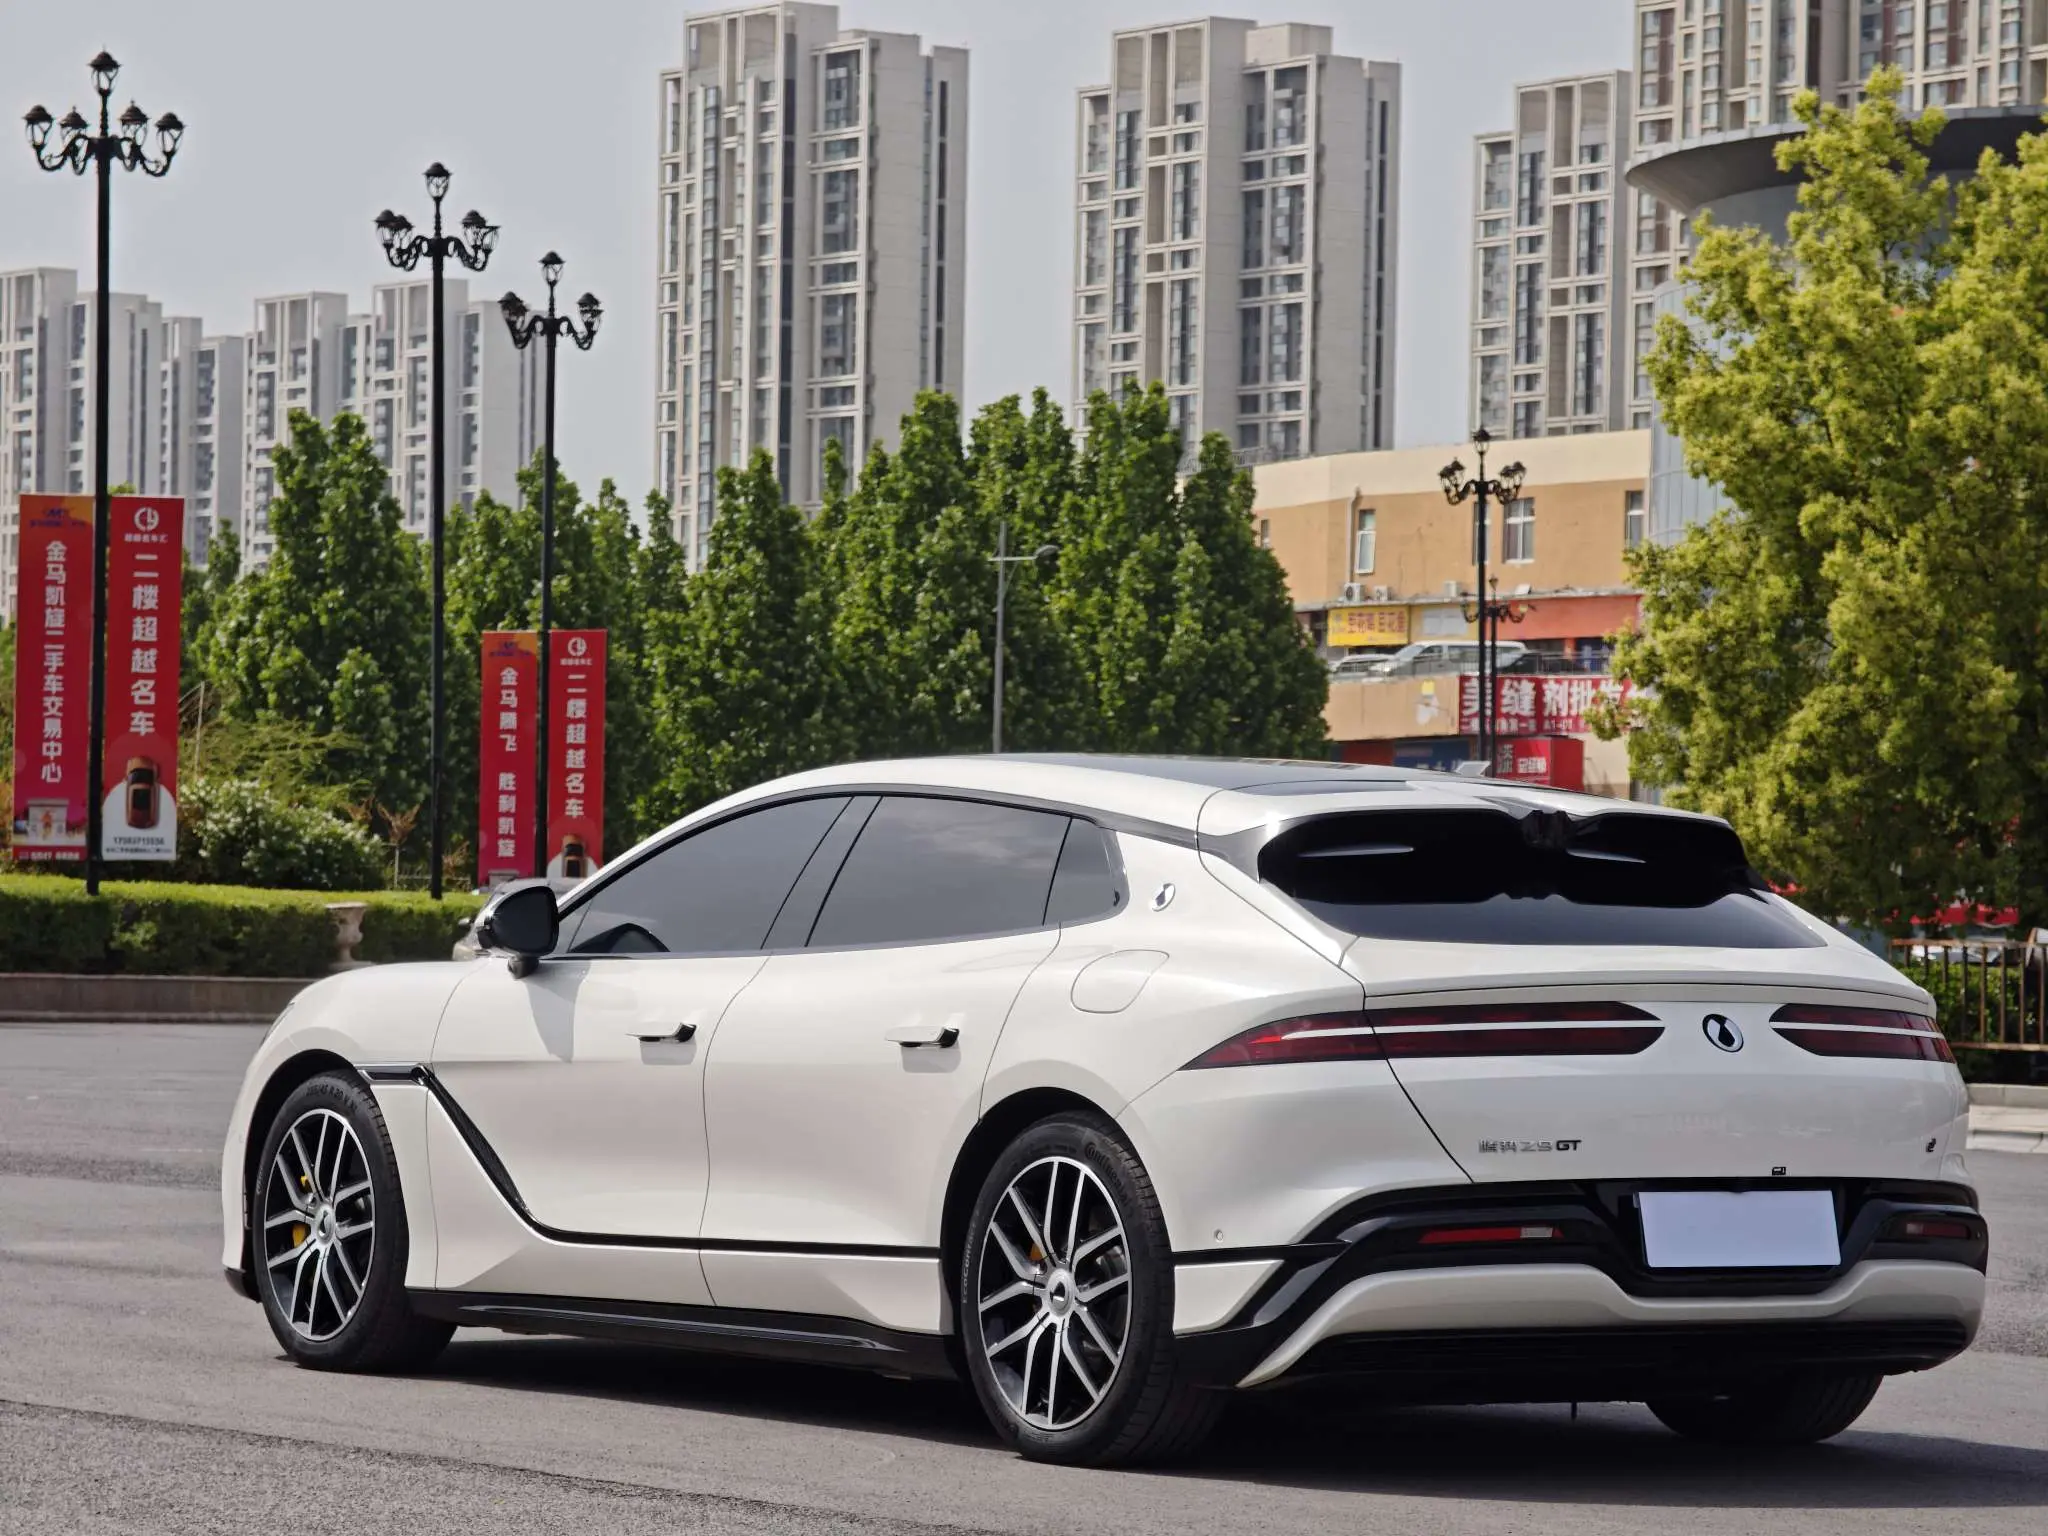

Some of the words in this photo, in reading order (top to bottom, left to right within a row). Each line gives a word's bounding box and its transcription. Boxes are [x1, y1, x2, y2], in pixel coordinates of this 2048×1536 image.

[42, 541, 67, 783] 金马凯旋二手车交易中心
[130, 554, 159, 736] 二楼超越名车
[1463, 677, 1656, 718] 美缝剂批发
[565, 674, 587, 818] 二楼超越名车
